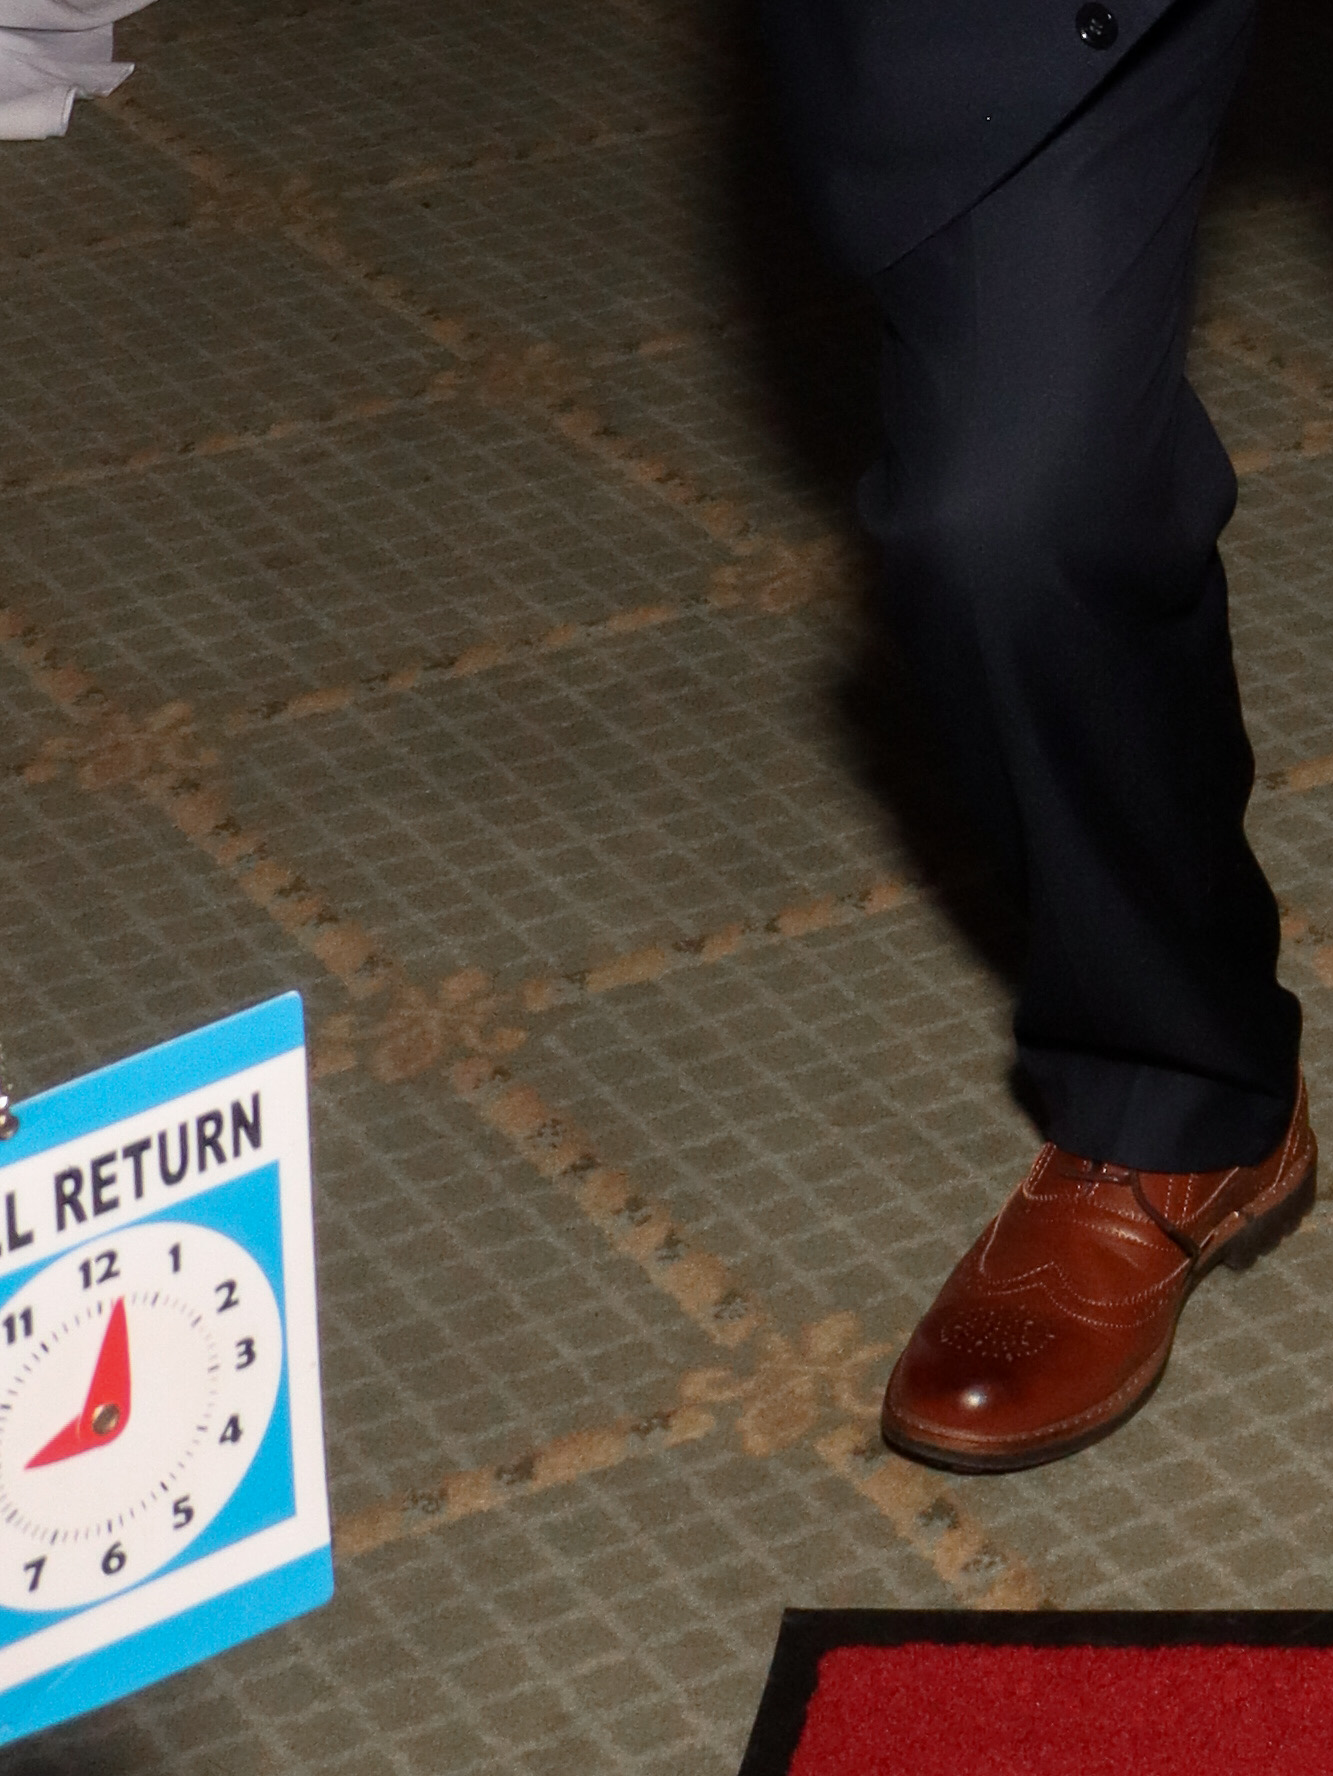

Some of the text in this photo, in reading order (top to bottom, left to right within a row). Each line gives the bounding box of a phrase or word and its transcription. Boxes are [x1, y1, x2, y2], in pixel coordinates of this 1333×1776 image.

[0, 1092, 262, 1257] L RETURN
[79, 1250, 120, 1290] 12
[169, 1244, 181, 1273] 1
[215, 1280, 239, 1313] 2
[3, 1308, 33, 1345] 11
[236, 1337, 256, 1369] 3
[219, 1414, 242, 1444] 4
[170, 1496, 194, 1529] 5
[24, 1557, 47, 1592] 7
[101, 1542, 127, 1576] 6
